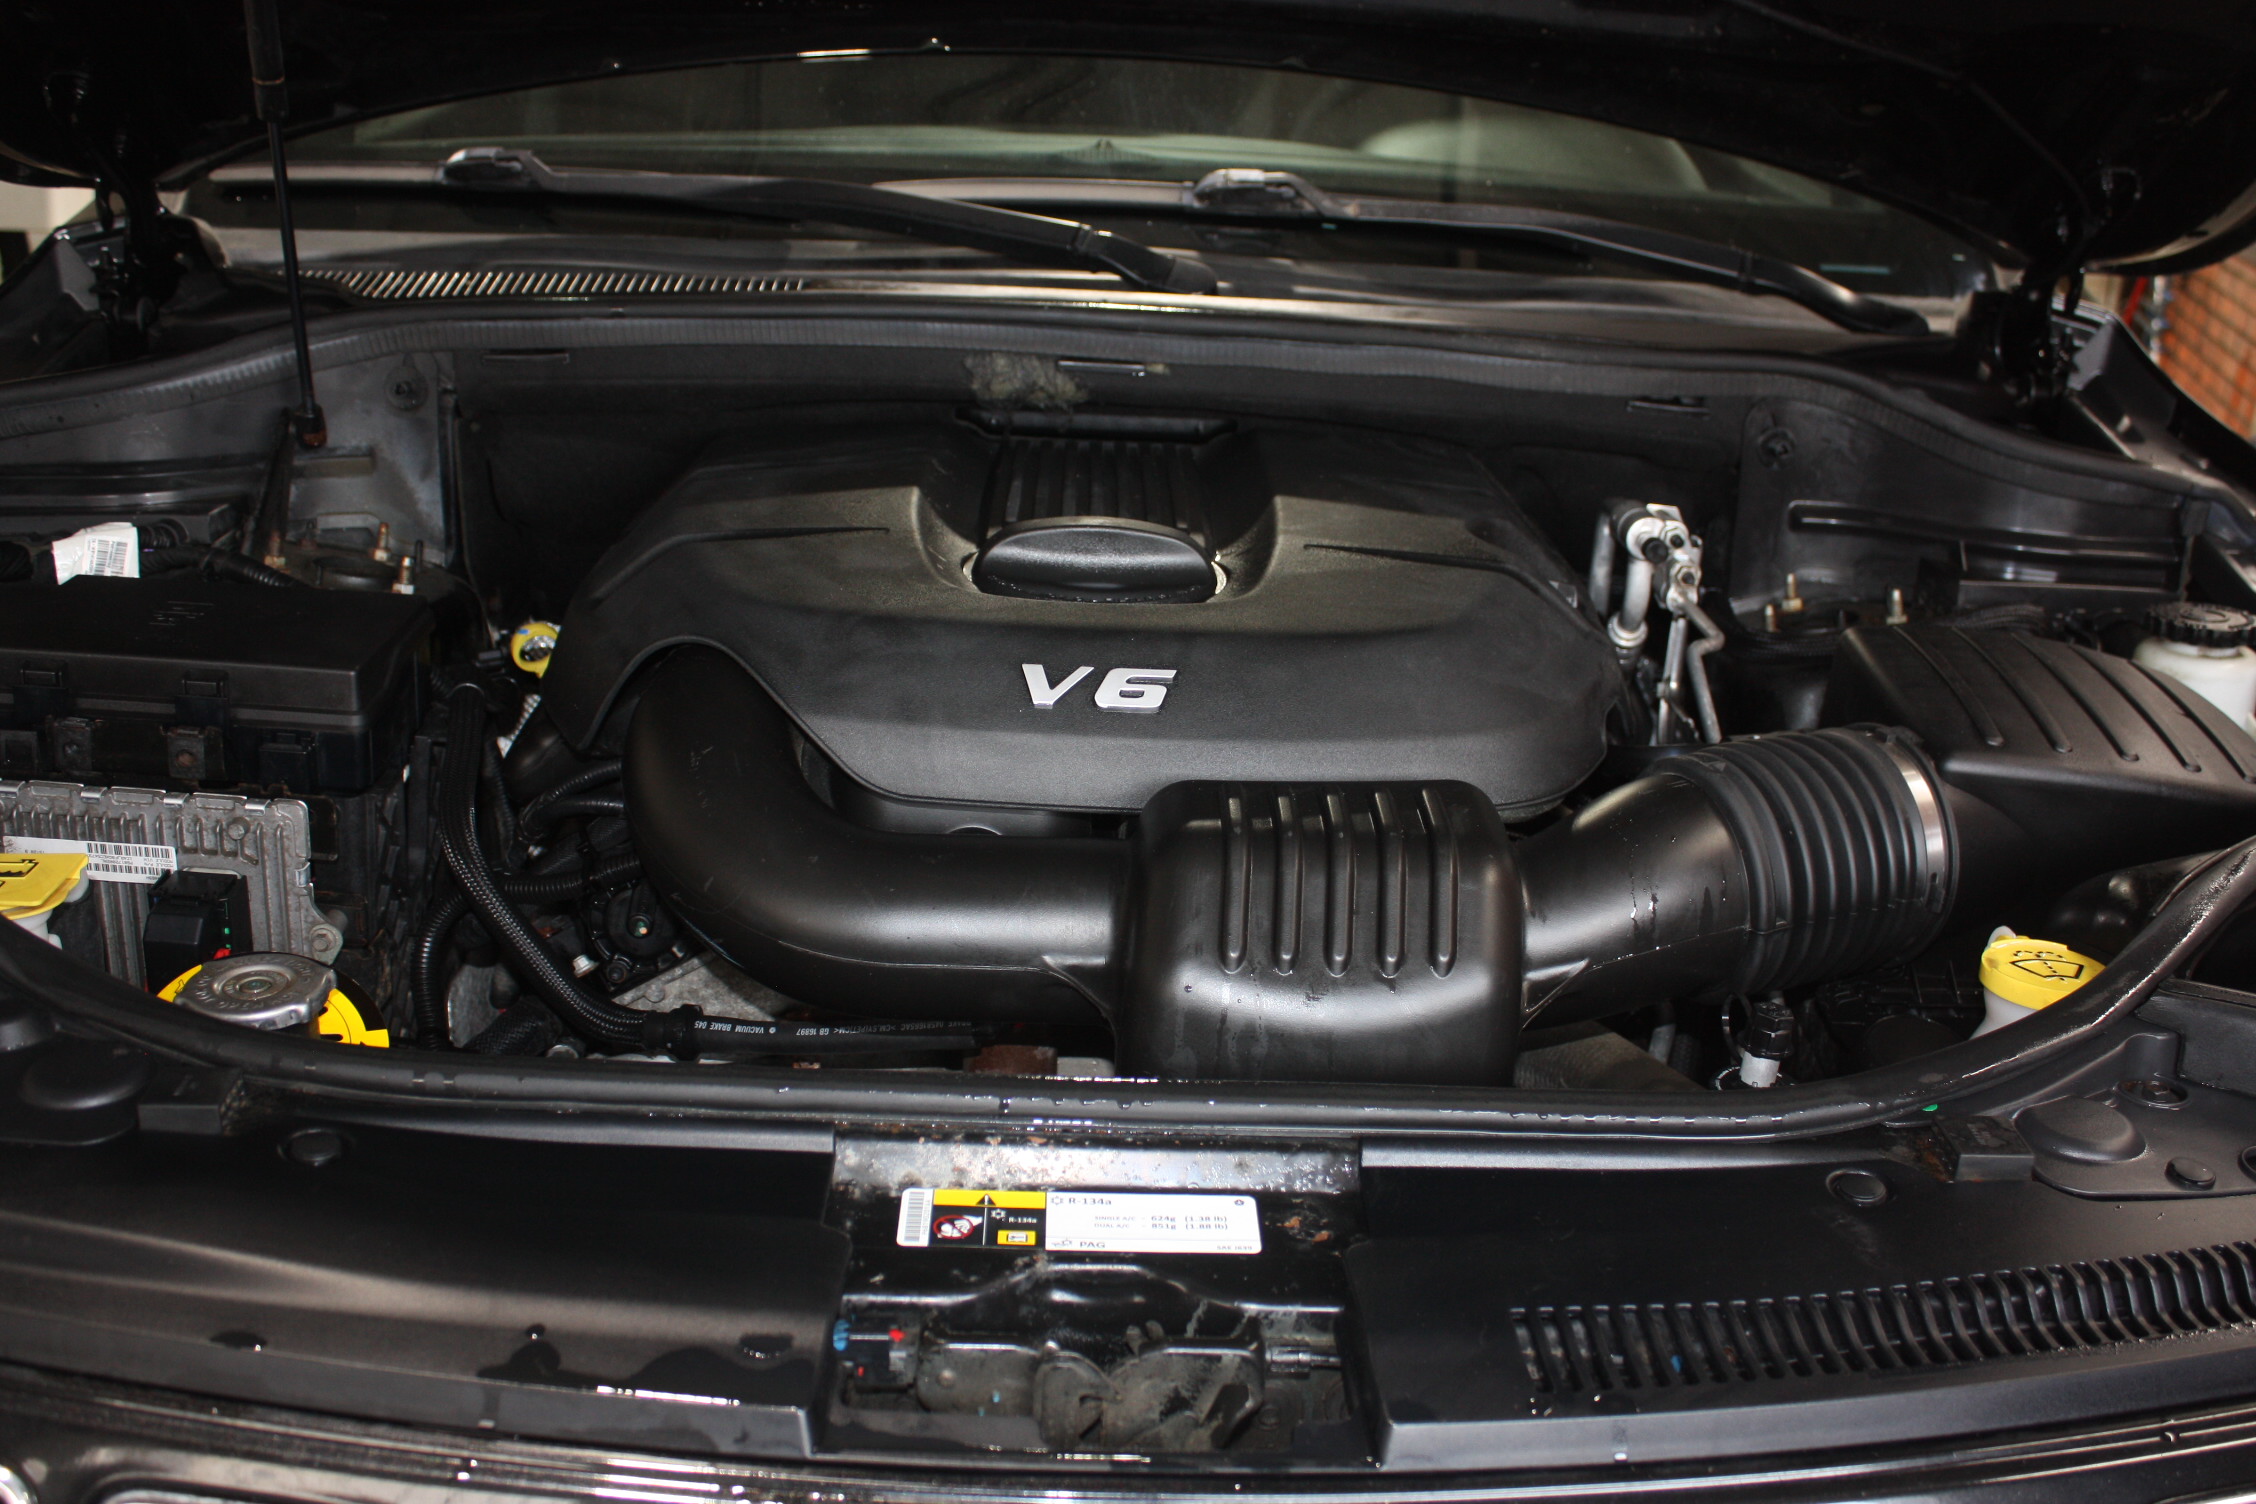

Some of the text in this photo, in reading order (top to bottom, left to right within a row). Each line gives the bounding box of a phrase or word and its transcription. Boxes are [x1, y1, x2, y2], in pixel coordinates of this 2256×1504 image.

[1021, 663, 1177, 713] V6
[709, 1021, 732, 1032] BRAKE
[734, 1023, 764, 1034] VACUUM
[796, 1027, 818, 1036] 16897
[819, 1027, 830, 1036] GB
[1068, 1196, 1112, 1206] R-134a
[1008, 1216, 1037, 1224] R-134a
[1079, 1241, 1106, 1249] PAG
